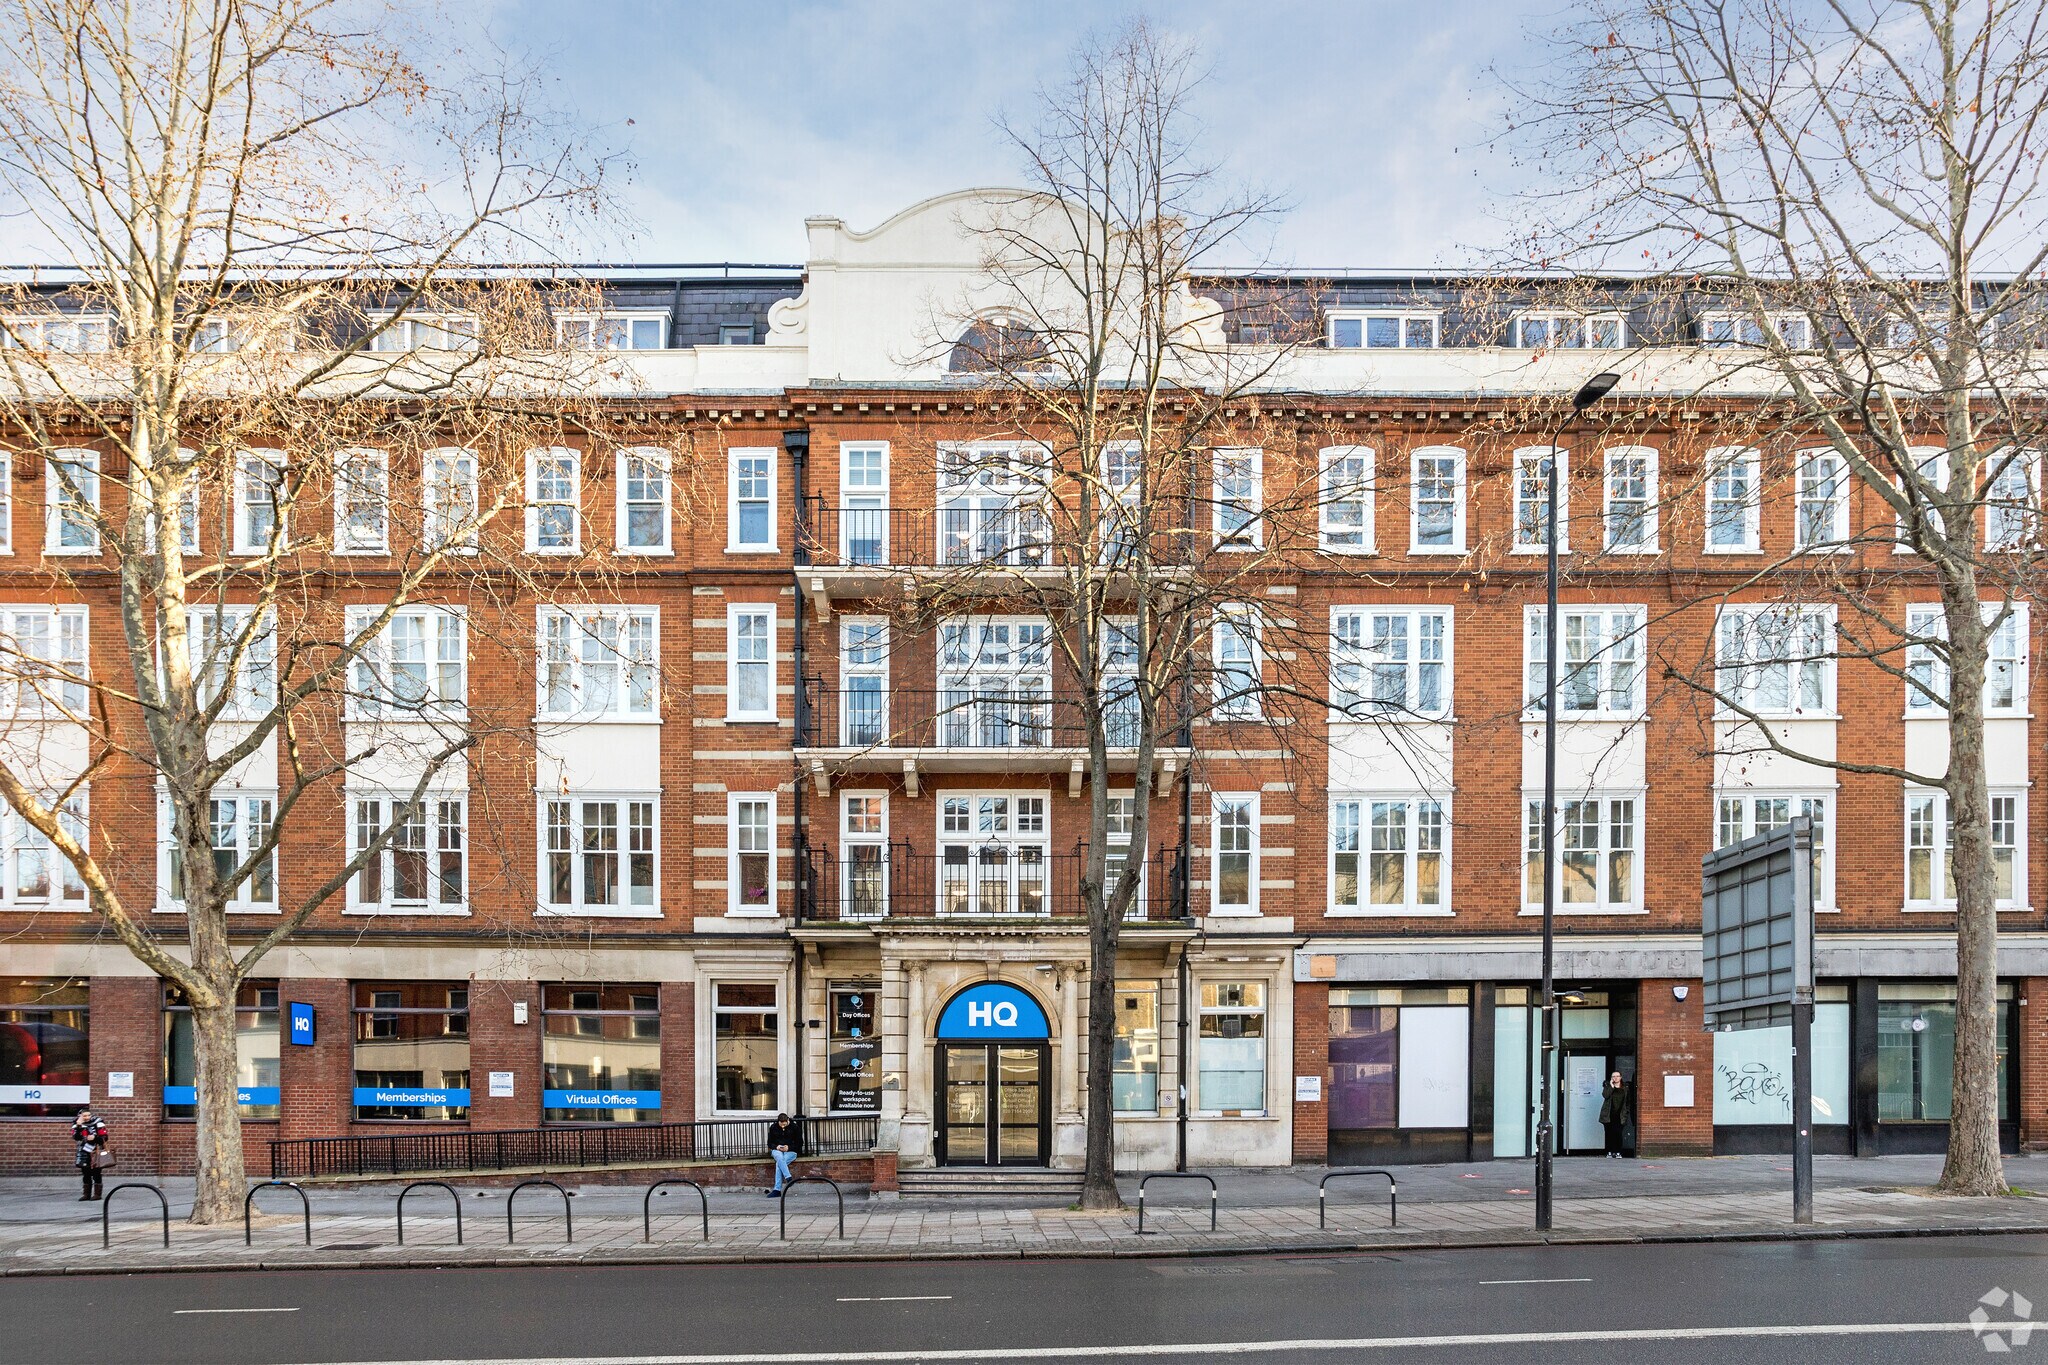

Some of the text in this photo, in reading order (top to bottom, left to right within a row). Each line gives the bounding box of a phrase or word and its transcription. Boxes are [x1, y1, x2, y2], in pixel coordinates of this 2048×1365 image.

[968, 1001, 1018, 1027] HQ
[295, 1016, 310, 1032] HQ
[24, 1090, 41, 1099] HQ
[376, 1092, 447, 1104] Memberships
[566, 1094, 638, 1105] Virtual Offices
